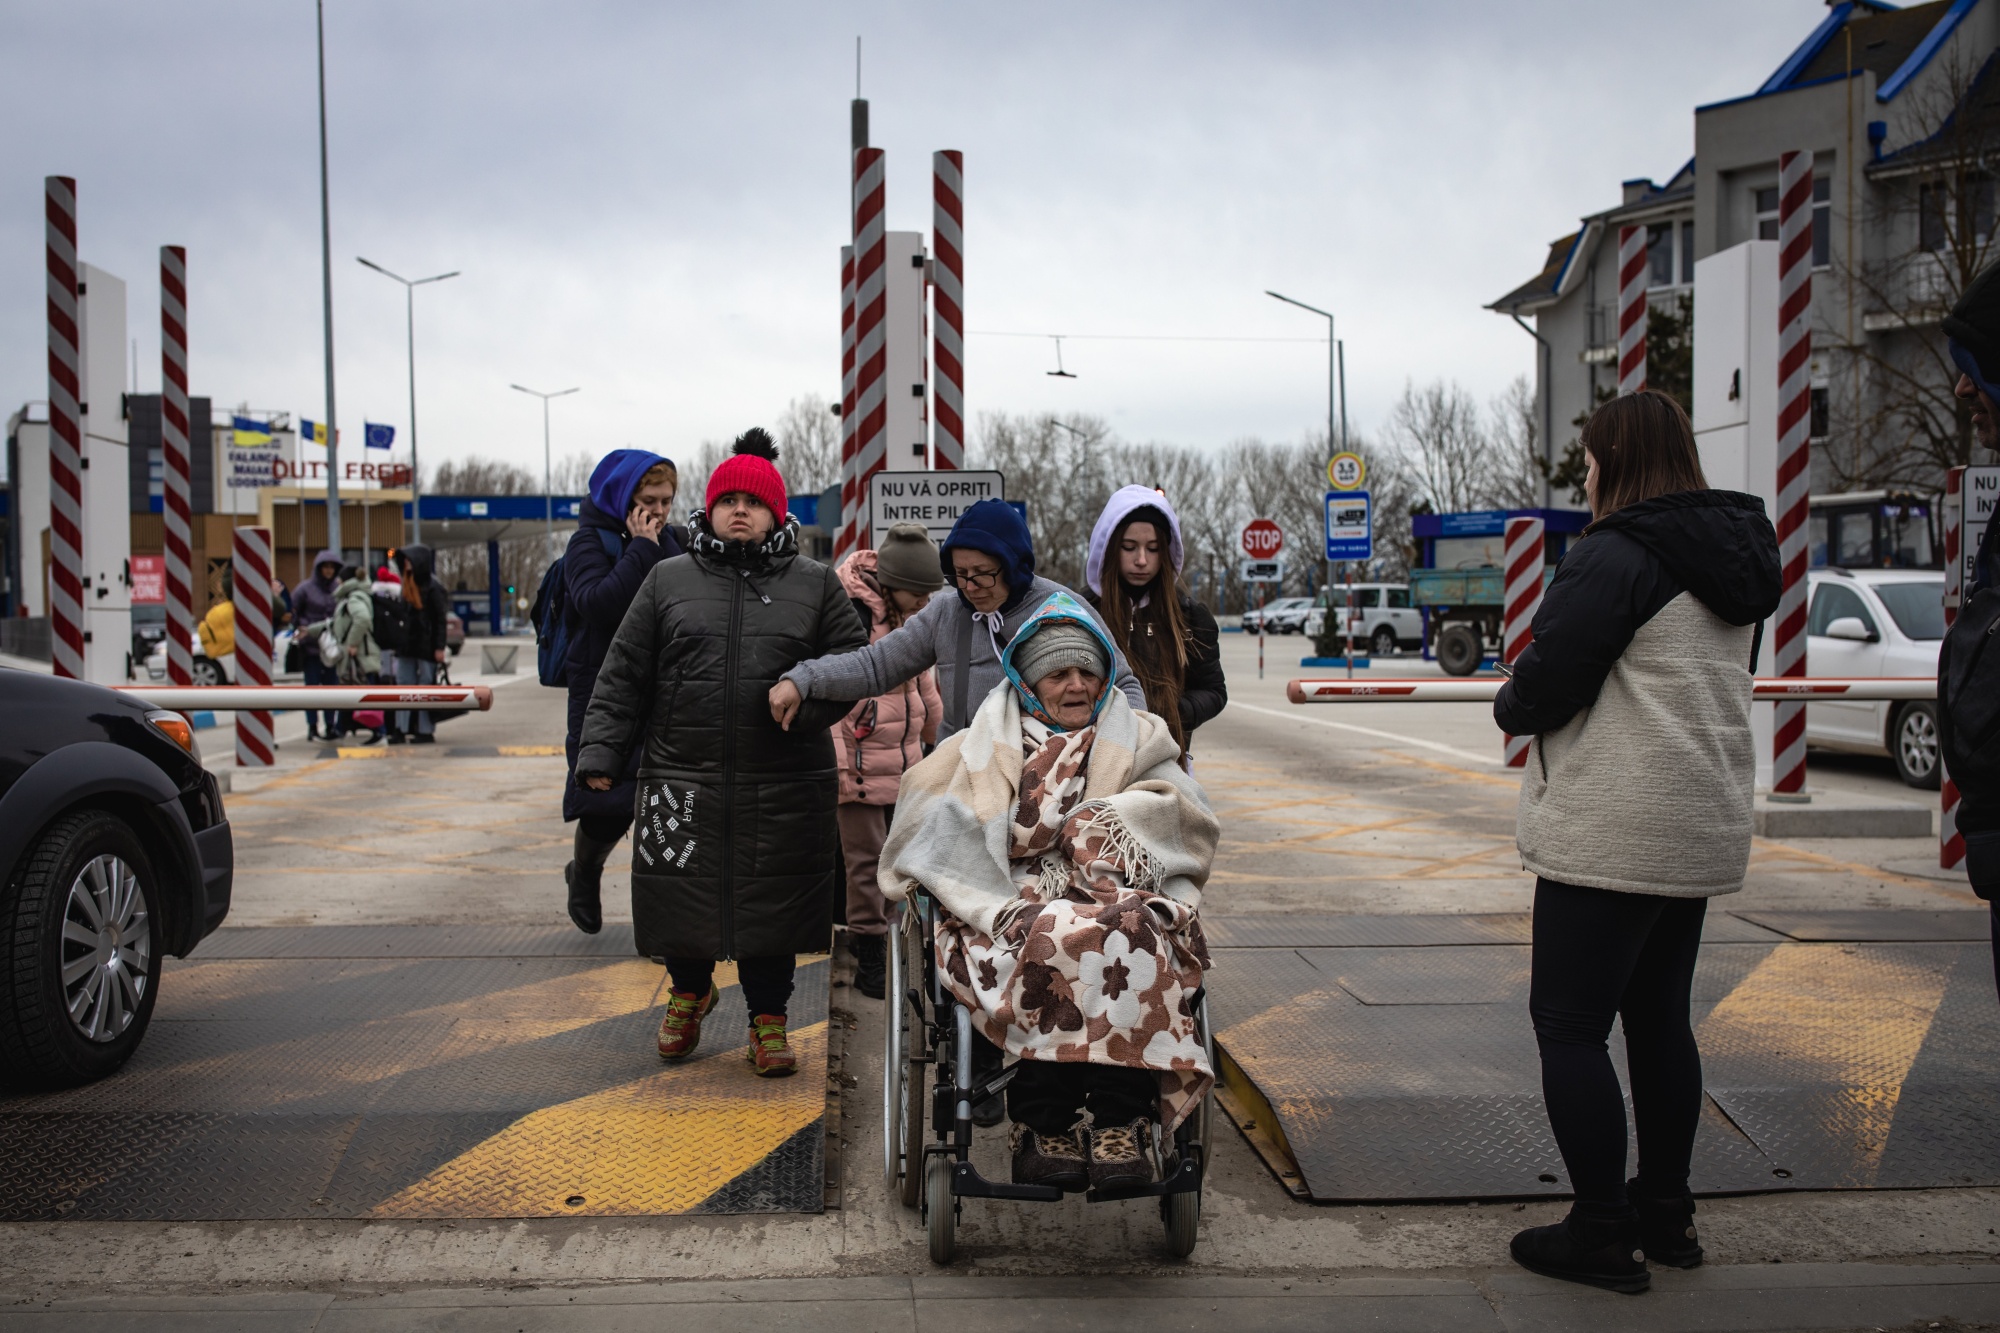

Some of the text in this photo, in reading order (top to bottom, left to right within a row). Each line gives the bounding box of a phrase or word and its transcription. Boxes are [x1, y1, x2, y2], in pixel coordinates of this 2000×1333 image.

[881, 483, 904, 496] NU
[909, 480, 932, 496] VĂ
[1975, 476, 1997, 490] NU
[883, 503, 932, 519] ÎNTRE
[1244, 529, 1280, 550] STOP
[661, 783, 680, 811] NOTHING
[682, 790, 695, 822] WEAR
[652, 812, 666, 844] WEAR
[676, 839, 697, 868] NOTHING
